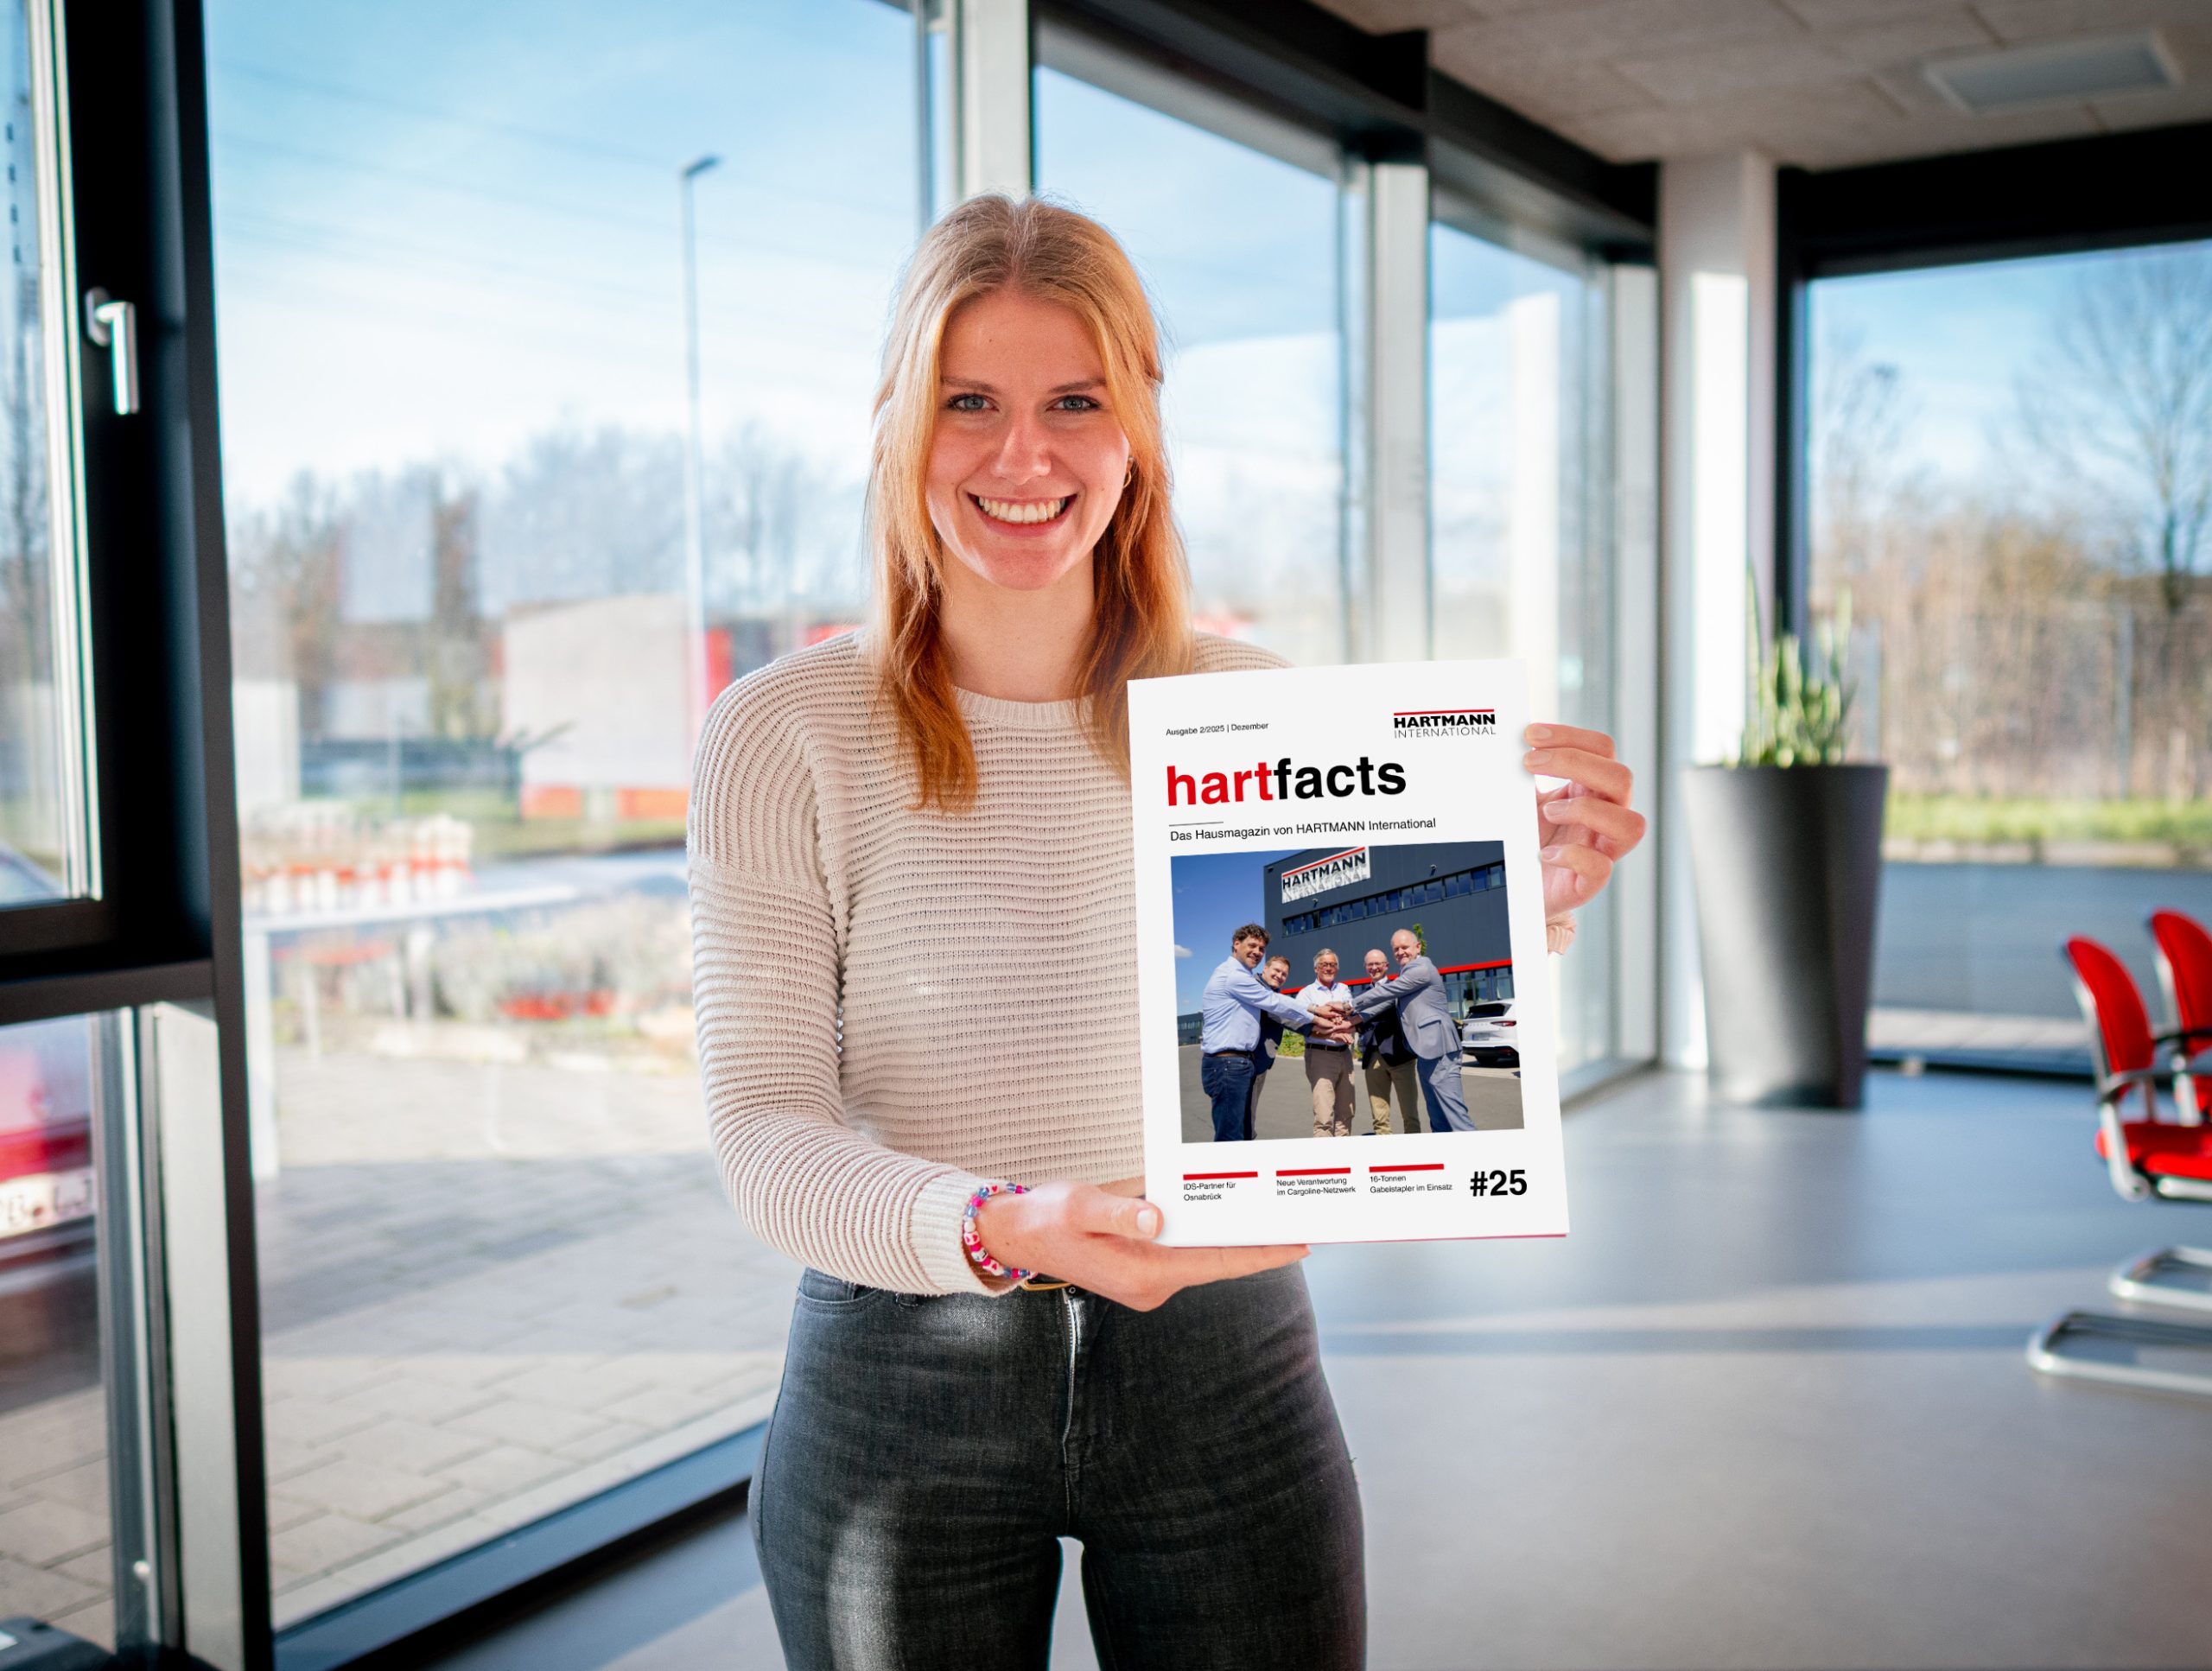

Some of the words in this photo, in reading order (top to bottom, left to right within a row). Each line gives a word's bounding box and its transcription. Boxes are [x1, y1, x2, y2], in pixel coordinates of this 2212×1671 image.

[1394, 714, 1496, 728] HARTMANN
[1166, 727, 1198, 736] Ausgabe
[1199, 725, 1225, 734] 2/2025
[1231, 722, 1269, 731] Dezember
[1395, 727, 1497, 739] INTERNATIONAL
[1166, 757, 1407, 806] hartfacts
[1170, 831, 1192, 842] Das
[1195, 826, 1270, 840] Hausmagazin
[1273, 826, 1294, 835] von
[1296, 821, 1365, 834] HARTMANN
[1369, 817, 1436, 830] International
[1283, 853, 1365, 889] HARTMANN
[1370, 1185, 1415, 1193] Gabelstapler
[1470, 1170, 1528, 1197] #25
[1287, 1186, 1357, 1196] Cargoline-Netzwerk
